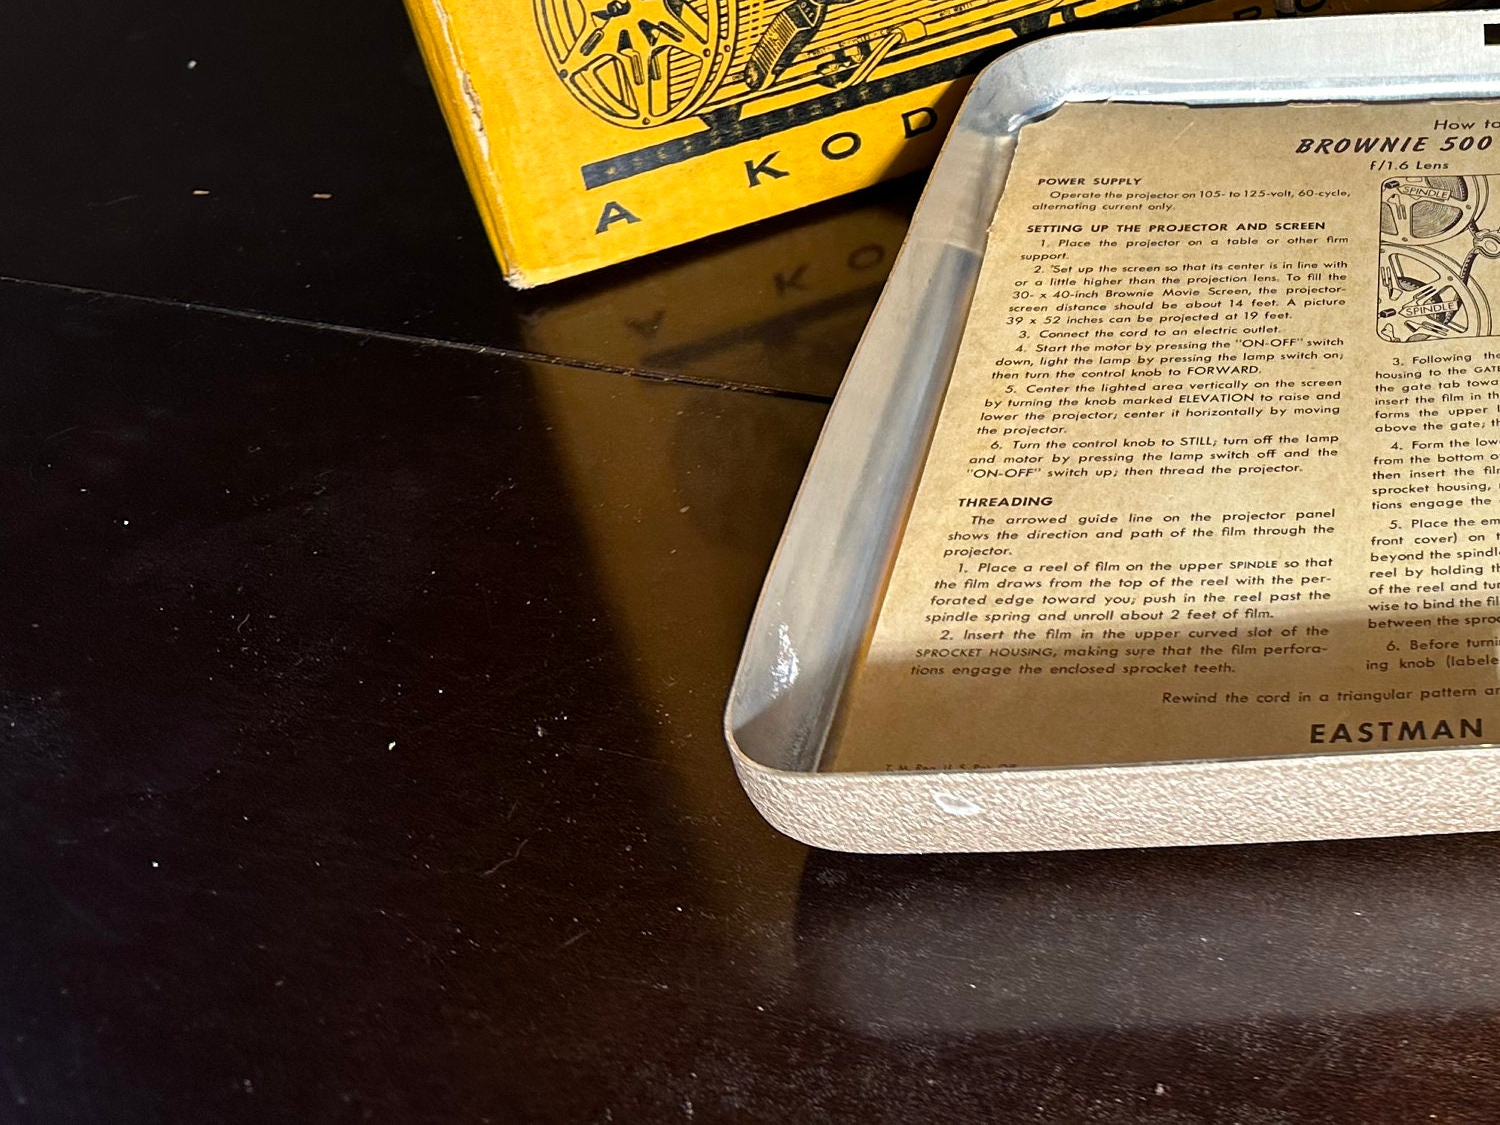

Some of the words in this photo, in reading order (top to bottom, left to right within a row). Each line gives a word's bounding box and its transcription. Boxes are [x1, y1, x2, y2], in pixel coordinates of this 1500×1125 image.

[1433, 119, 1476, 130] How
[1295, 136, 1429, 155] BROWNIE
[1439, 135, 1493, 152] 500
[595, 200, 642, 236] A
[743, 105, 939, 189] KOD
[1369, 159, 1409, 171] f/1.6
[1415, 160, 1449, 170] Lens
[1037, 177, 1086, 186] POWER
[1093, 177, 1142, 186] SUPPLY
[1049, 190, 1101, 201] Operate
[1104, 191, 1123, 199] the
[1125, 192, 1179, 201] projector
[1199, 190, 1225, 199] 105-
[1244, 189, 1295, 199] 125-volt,
[1297, 189, 1351, 198] 60-cycle,
[1402, 185, 1448, 199] SPINDLE
[1031, 202, 1097, 212] alternating
[1102, 203, 1143, 211] current
[1147, 202, 1175, 212] only.
[1026, 224, 1083, 233] SETTING
[1091, 224, 1109, 233] UP
[1116, 224, 1141, 233] THE
[1148, 223, 1228, 233] PROJECTOR
[1235, 222, 1268, 231] AND
[1275, 221, 1326, 231] SCREEN
[1404, 302, 1458, 315] SPINDLE
[1392, 357, 1404, 367] 3.
[1412, 353, 1472, 365] Following
[958, 496, 1053, 507] THREADING
[971, 515, 996, 525] The
[1005, 514, 1068, 525] arrowed
[1078, 513, 1119, 526] guide
[1128, 513, 1153, 523] line
[1163, 515, 1180, 523] on
[1190, 512, 1212, 522] the
[1222, 511, 1286, 524] projector
[1295, 508, 1336, 521] panel
[1162, 691, 1218, 704] Rewind
[1225, 691, 1249, 704] the
[1256, 690, 1291, 704] cord
[1298, 691, 1311, 702] in
[1318, 694, 1329, 702] a
[1336, 688, 1413, 703] triangular
[1419, 687, 1477, 702] pattern
[1310, 717, 1482, 744] EASTMAN
